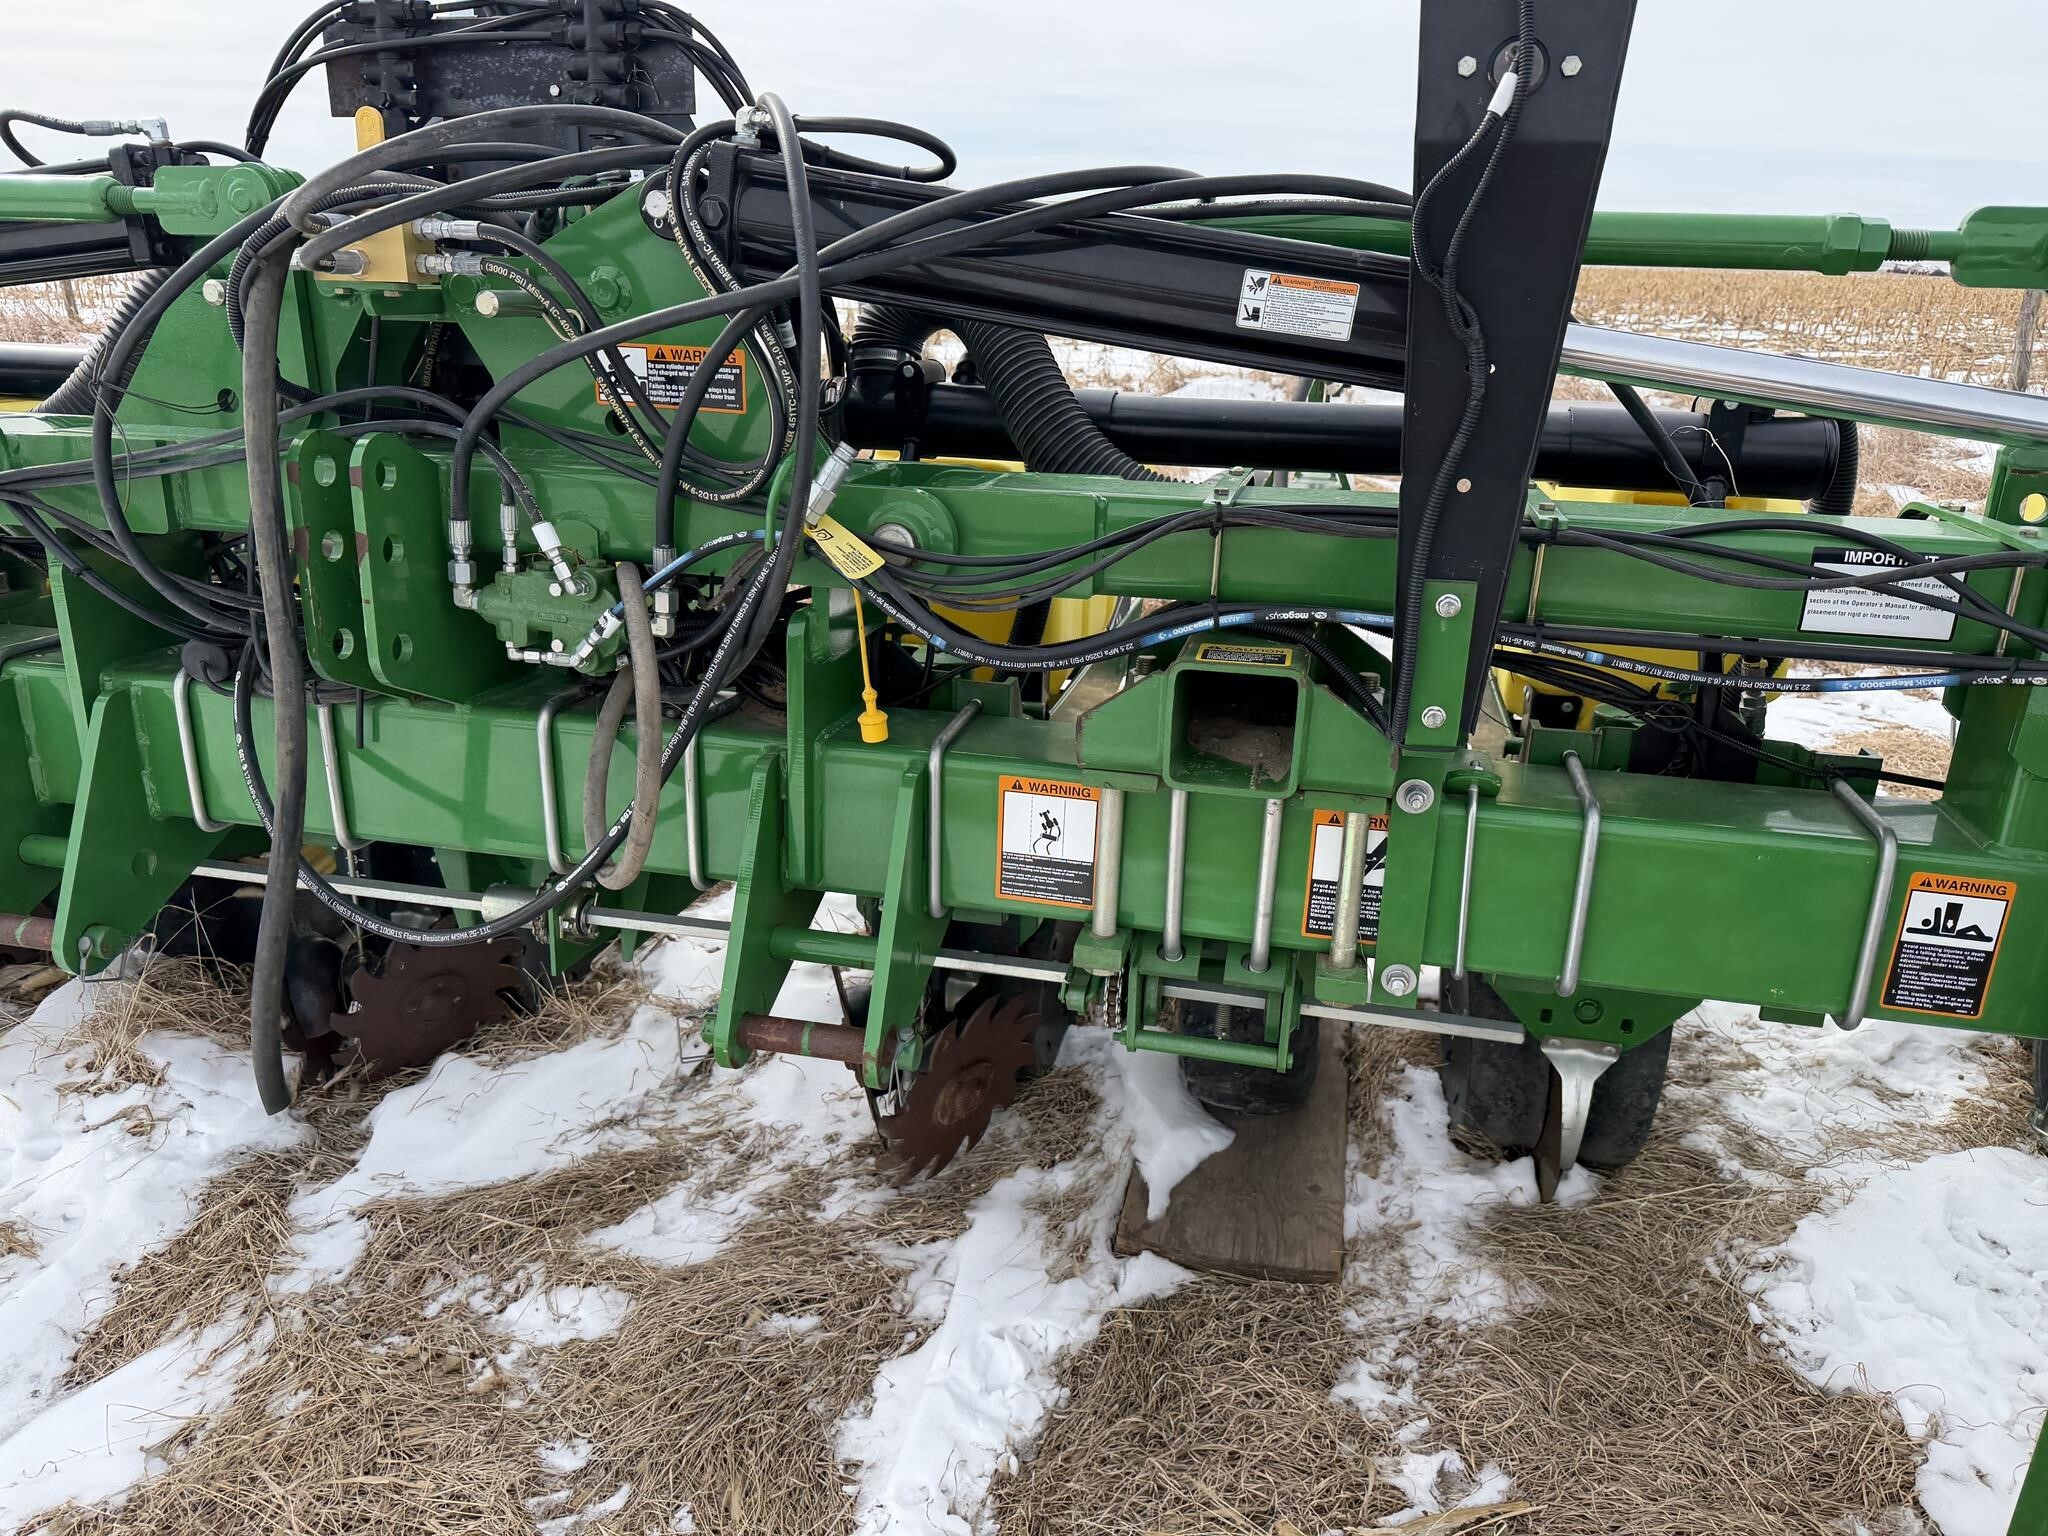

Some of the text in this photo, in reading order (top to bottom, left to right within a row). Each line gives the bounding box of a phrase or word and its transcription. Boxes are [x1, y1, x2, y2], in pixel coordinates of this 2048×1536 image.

[711, 256, 732, 282] MSHA
[485, 262, 508, 276] (3000
[509, 272, 527, 288] PSI)
[527, 283, 550, 308] MSHA
[729, 279, 742, 292] SI)
[1283, 278, 1311, 287] WARNING
[761, 324, 777, 346] MPa
[671, 349, 736, 364] WARG
[772, 346, 787, 366] 21.0
[666, 364, 685, 372] cylinder
[659, 370, 677, 378] charged
[782, 369, 793, 387] WP
[596, 376, 655, 461] SAE100R17-4 6.3 mm
[690, 488, 718, 501] 6-2Q13
[720, 469, 765, 500] www.parker.com
[1844, 550, 1939, 566] IMPORT
[883, 602, 897, 615] MSHA
[1851, 600, 1883, 609] Operator's
[1807, 608, 1837, 616] placement
[1847, 610, 1860, 619] rigid
[1882, 614, 1912, 622] operation.
[706, 651, 725, 682] ISO1436
[721, 633, 733, 651] 1SN
[732, 603, 750, 628] EN853
[747, 587, 758, 604] 1SN
[758, 567, 770, 583] SAE
[896, 612, 917, 630] Resistant
[917, 626, 931, 639] Flame
[1500, 635, 1522, 645] 2G-11C
[1522, 640, 1536, 648] SHA
[1103, 646, 1119, 655] MPa
[1119, 642, 1134, 651] 22.5
[1540, 643, 1567, 654] Resistant
[1070, 655, 1084, 663] PSI)
[1085, 651, 1103, 660] (3250
[1567, 650, 1585, 659] Flame
[1056, 658, 1069, 667] 1/4"
[1611, 659, 1634, 670] 100R17
[1635, 663, 1646, 672] SAE
[1650, 666, 1662, 675] R17
[1662, 668, 1690, 680] ISO11237
[1691, 673, 1707, 682] mm)
[1707, 677, 1722, 685] (6.3
[1722, 678, 1735, 686] 1/4"
[1738, 680, 1752, 688] PSI)
[1755, 681, 1775, 689] (3250
[1860, 680, 1914, 689] Mega3000
[1029, 782, 1091, 798] WARNING
[1935, 878, 2007, 896] WARNING
[298, 869, 492, 942] SO1436 1SN EN853 1SN SAE 100R1S Flame Resistant MSHA 2G-11C
[1909, 980, 1943, 988] recommended
